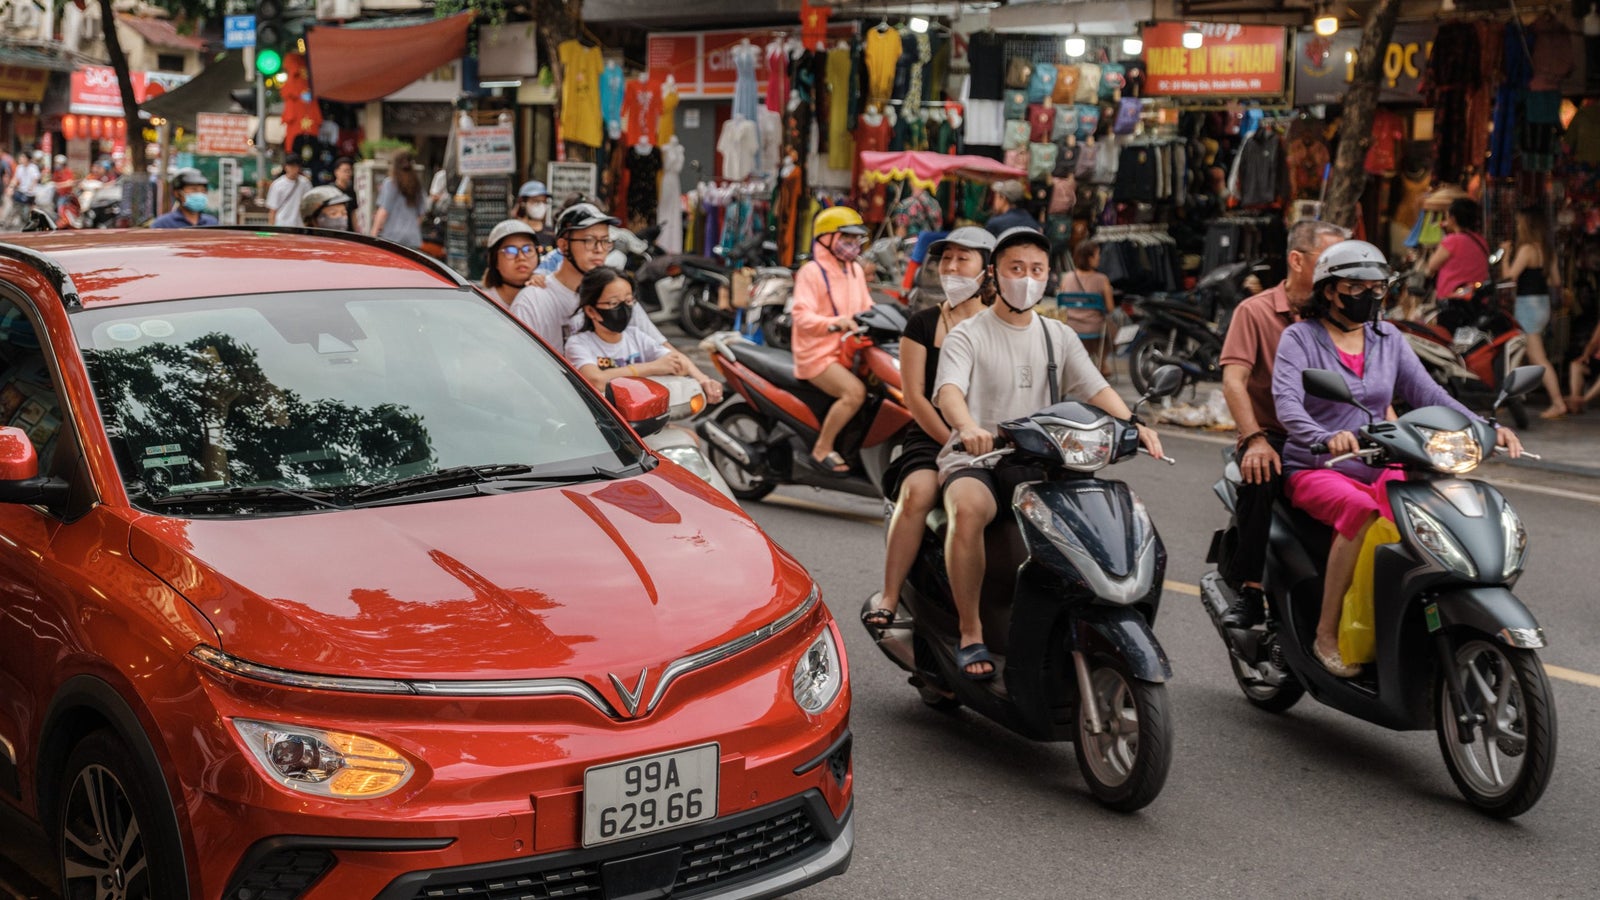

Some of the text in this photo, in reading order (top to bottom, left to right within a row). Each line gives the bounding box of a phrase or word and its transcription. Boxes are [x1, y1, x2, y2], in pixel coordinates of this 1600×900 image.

[1147, 46, 1188, 75] MADE
[1190, 46, 1208, 75] IN
[1210, 43, 1277, 74] VIETNAM
[625, 757, 680, 797] 99A
[600, 788, 703, 838] 629.66
